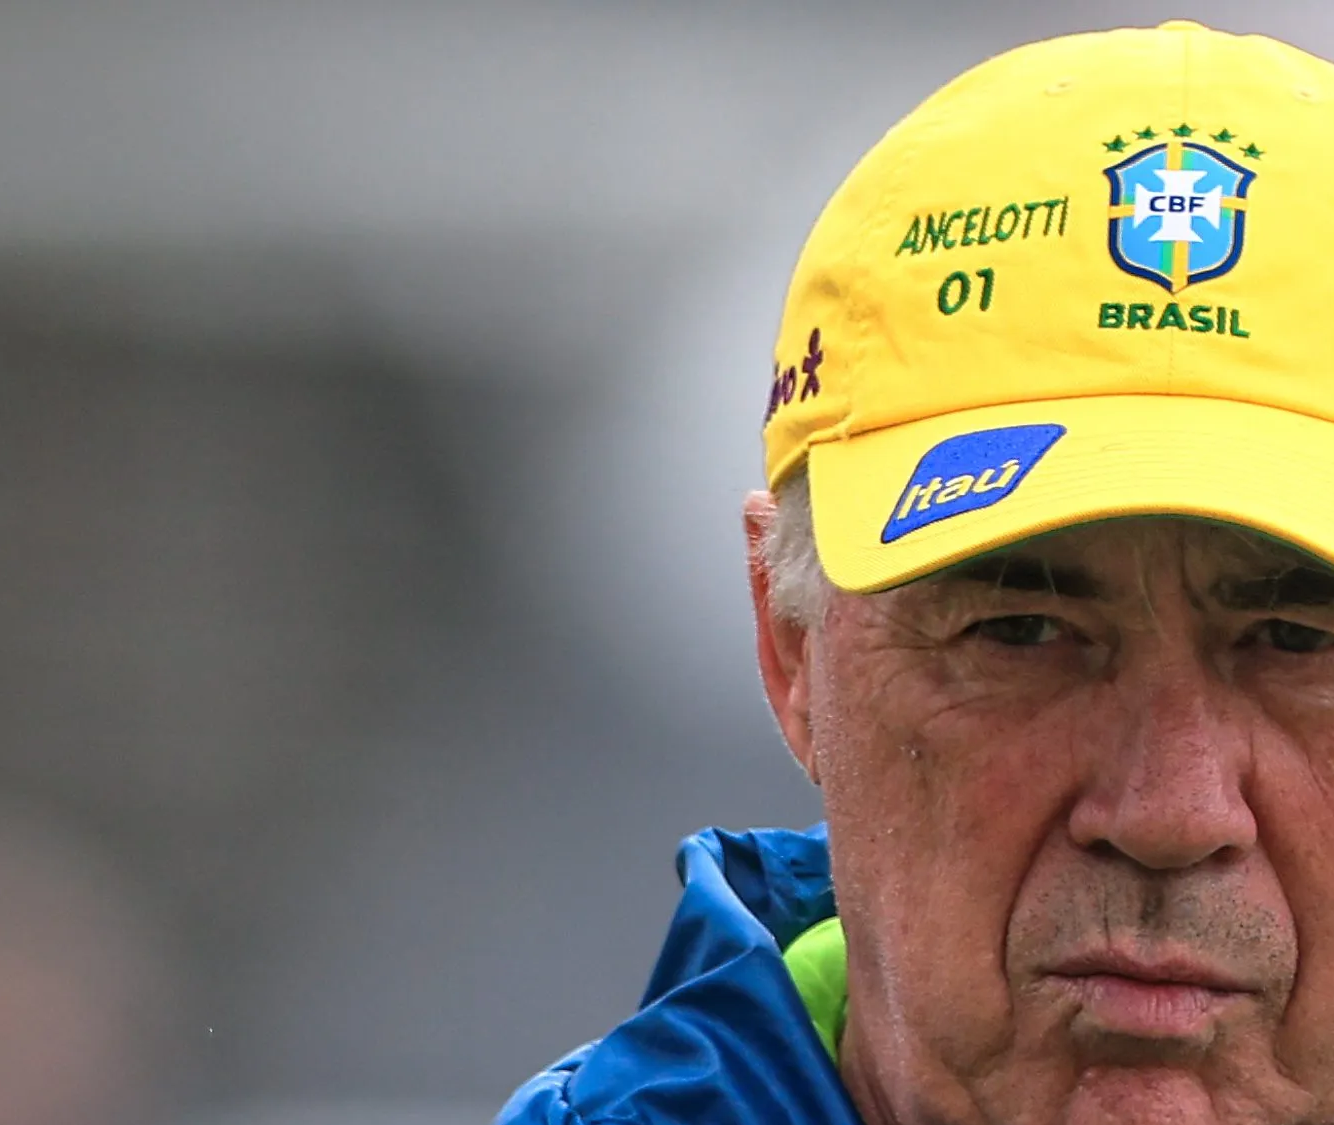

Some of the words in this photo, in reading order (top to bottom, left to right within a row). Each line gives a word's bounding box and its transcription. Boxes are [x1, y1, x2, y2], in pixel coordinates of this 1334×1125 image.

[895, 196, 1069, 258] ANCELOTTI
[1149, 195, 1206, 214] CBF
[937, 268, 995, 316] 01
[1098, 302, 1251, 338] BRASIL
[896, 459, 1020, 520] Itaú
